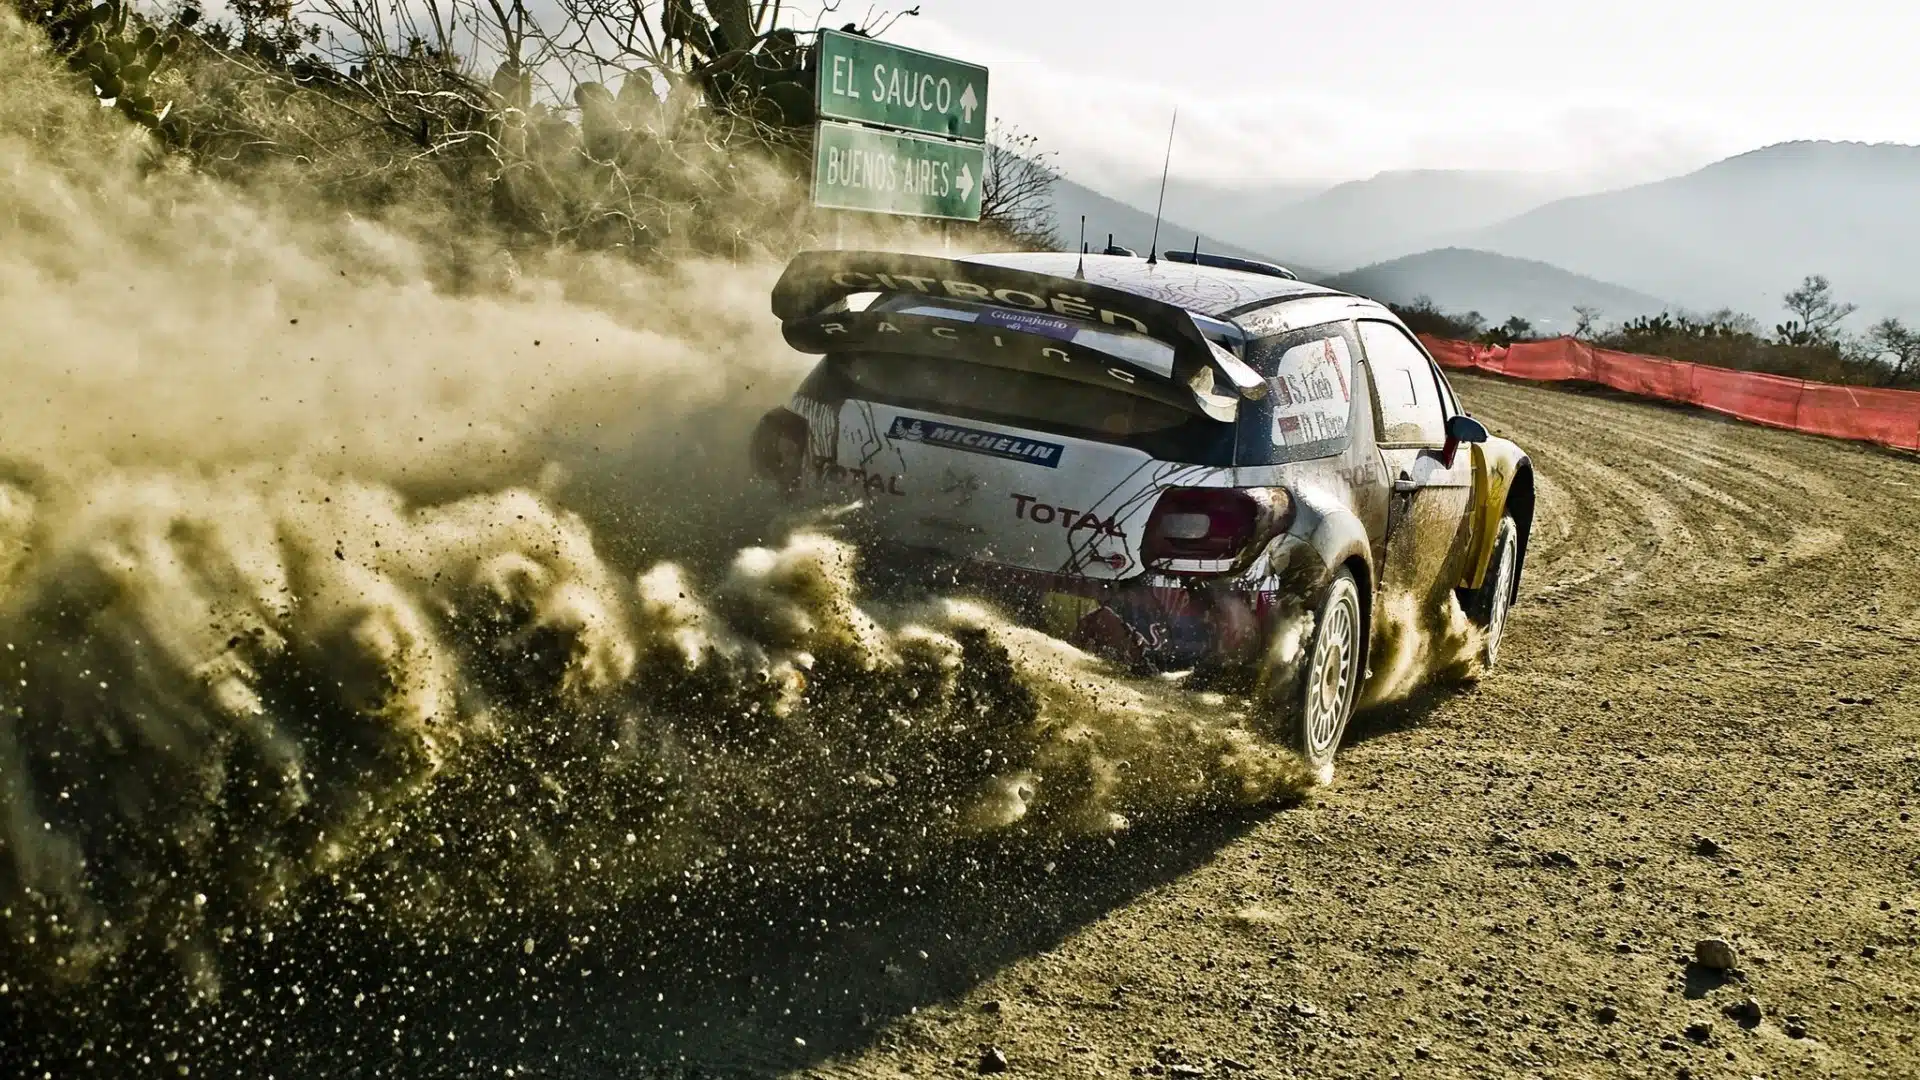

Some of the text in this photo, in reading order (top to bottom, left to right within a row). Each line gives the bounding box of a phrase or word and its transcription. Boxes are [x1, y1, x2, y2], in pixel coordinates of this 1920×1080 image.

[832, 55, 950, 114] EL SAUCO
[827, 147, 949, 197] BUENOS AIRES
[991, 309, 1069, 330] Guanajuato
[820, 321, 1135, 384] RACING
[930, 427, 1055, 459] MICHELIN
[813, 455, 906, 497] TOTAL
[1010, 493, 1127, 538] TOTAL
